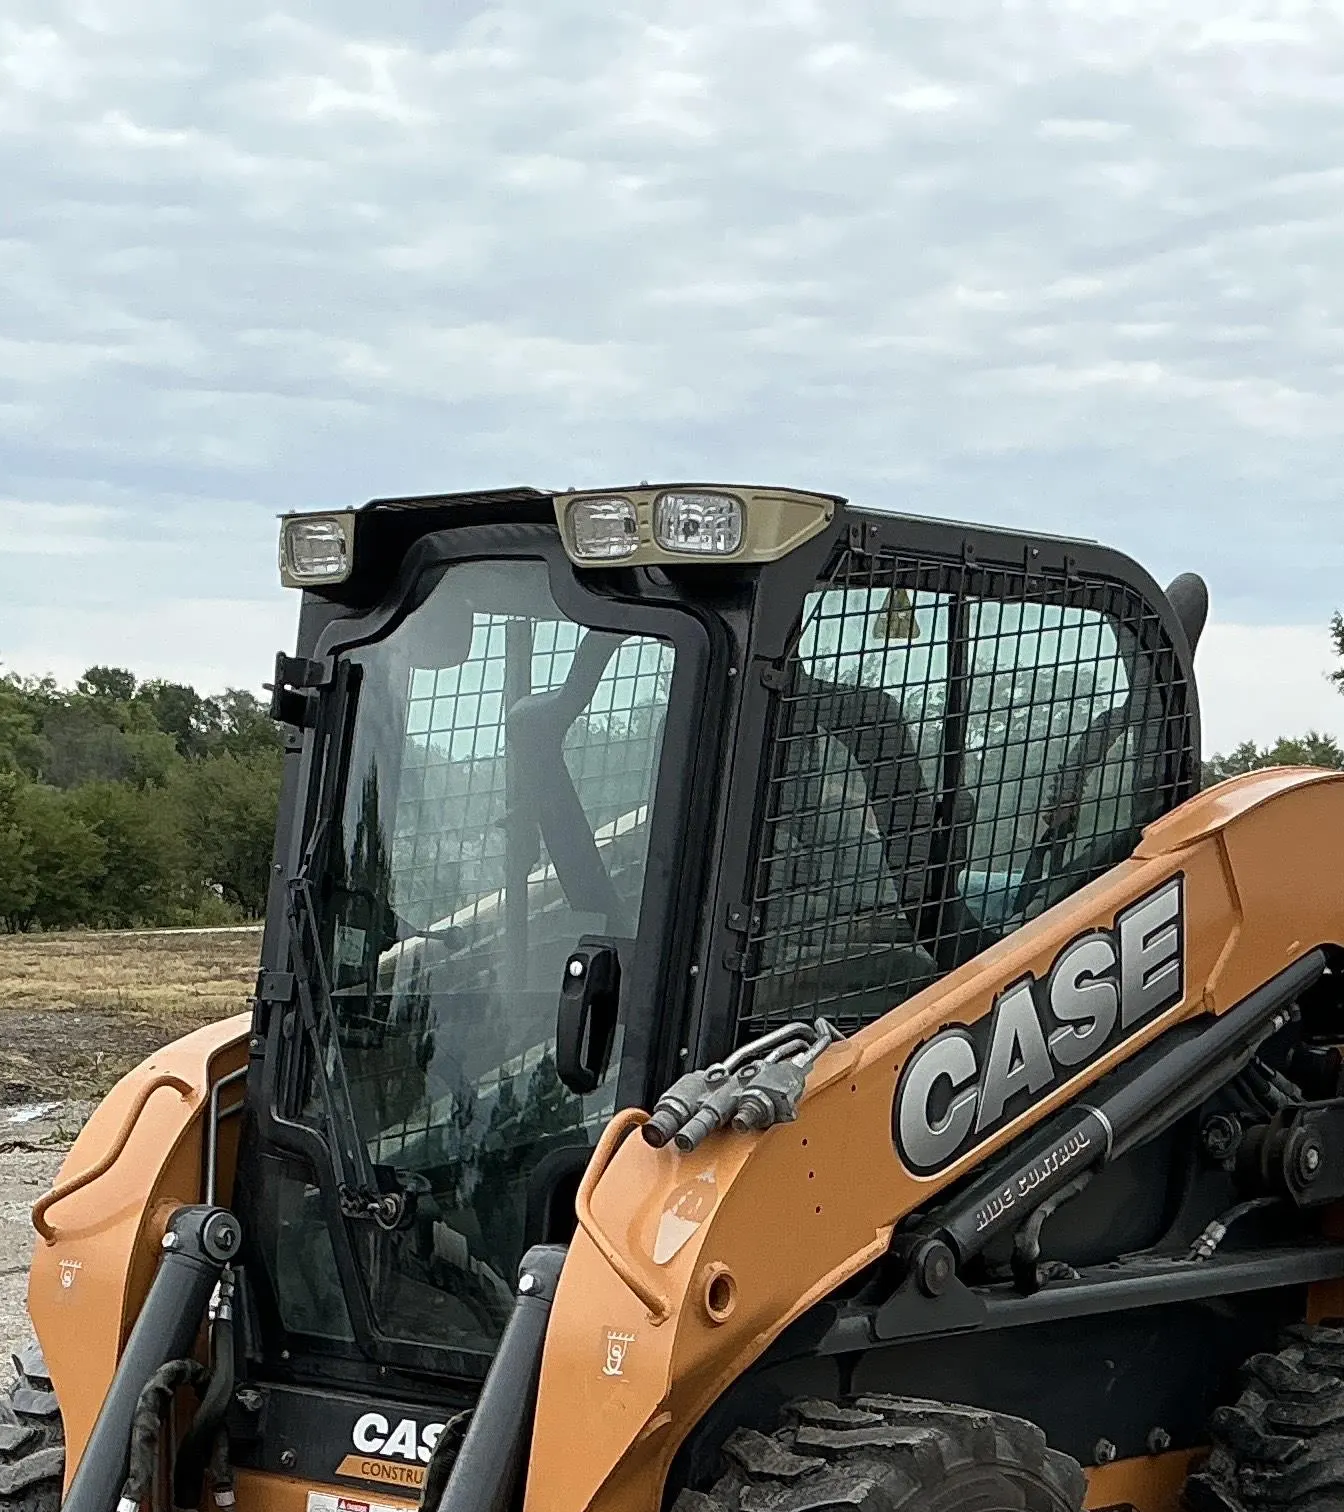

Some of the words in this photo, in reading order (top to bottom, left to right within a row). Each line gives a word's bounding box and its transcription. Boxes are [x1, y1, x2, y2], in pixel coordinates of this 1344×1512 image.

[898, 878, 1183, 1168] CASE
[976, 1188, 1016, 1232] RIDE
[1018, 1131, 1091, 1197] CONTROL
[352, 1412, 447, 1463] CAS
[361, 1461, 424, 1485] CONSTRU
